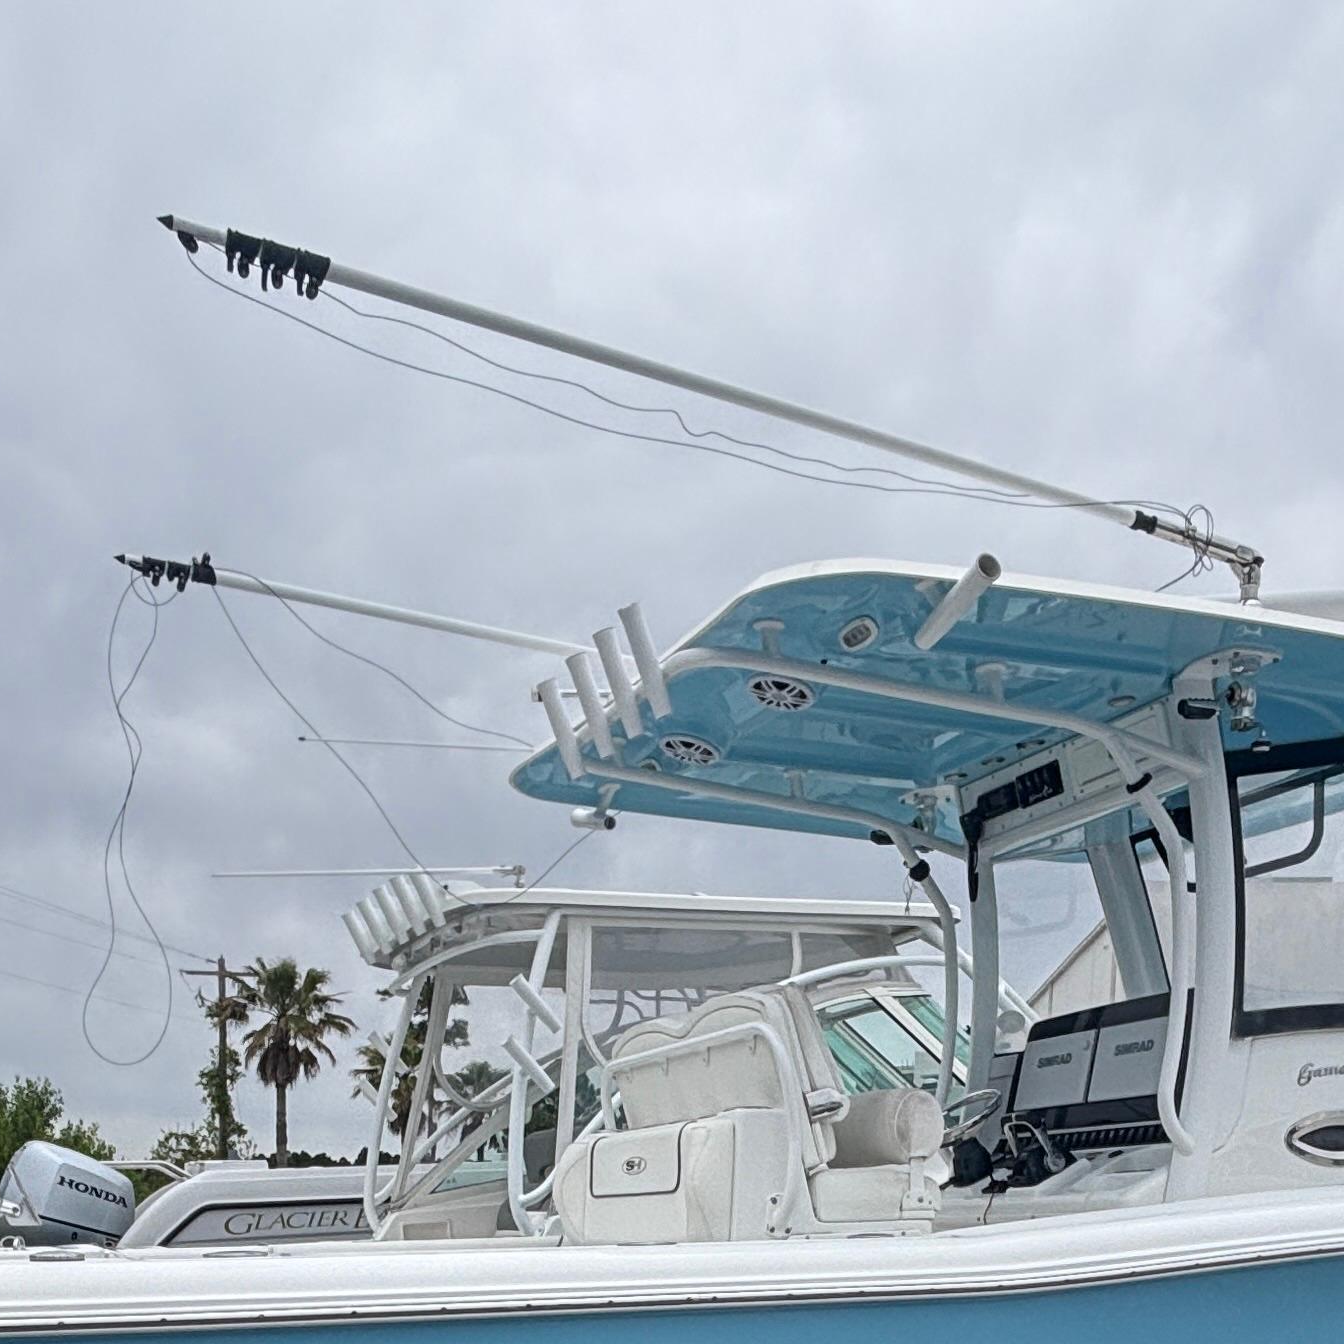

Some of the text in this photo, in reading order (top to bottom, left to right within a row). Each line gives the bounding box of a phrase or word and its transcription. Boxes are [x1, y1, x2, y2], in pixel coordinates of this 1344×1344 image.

[1114, 1039, 1155, 1057] SIMRAD
[56, 1175, 128, 1209] HONDA
[224, 1209, 350, 1236] GLACIER
